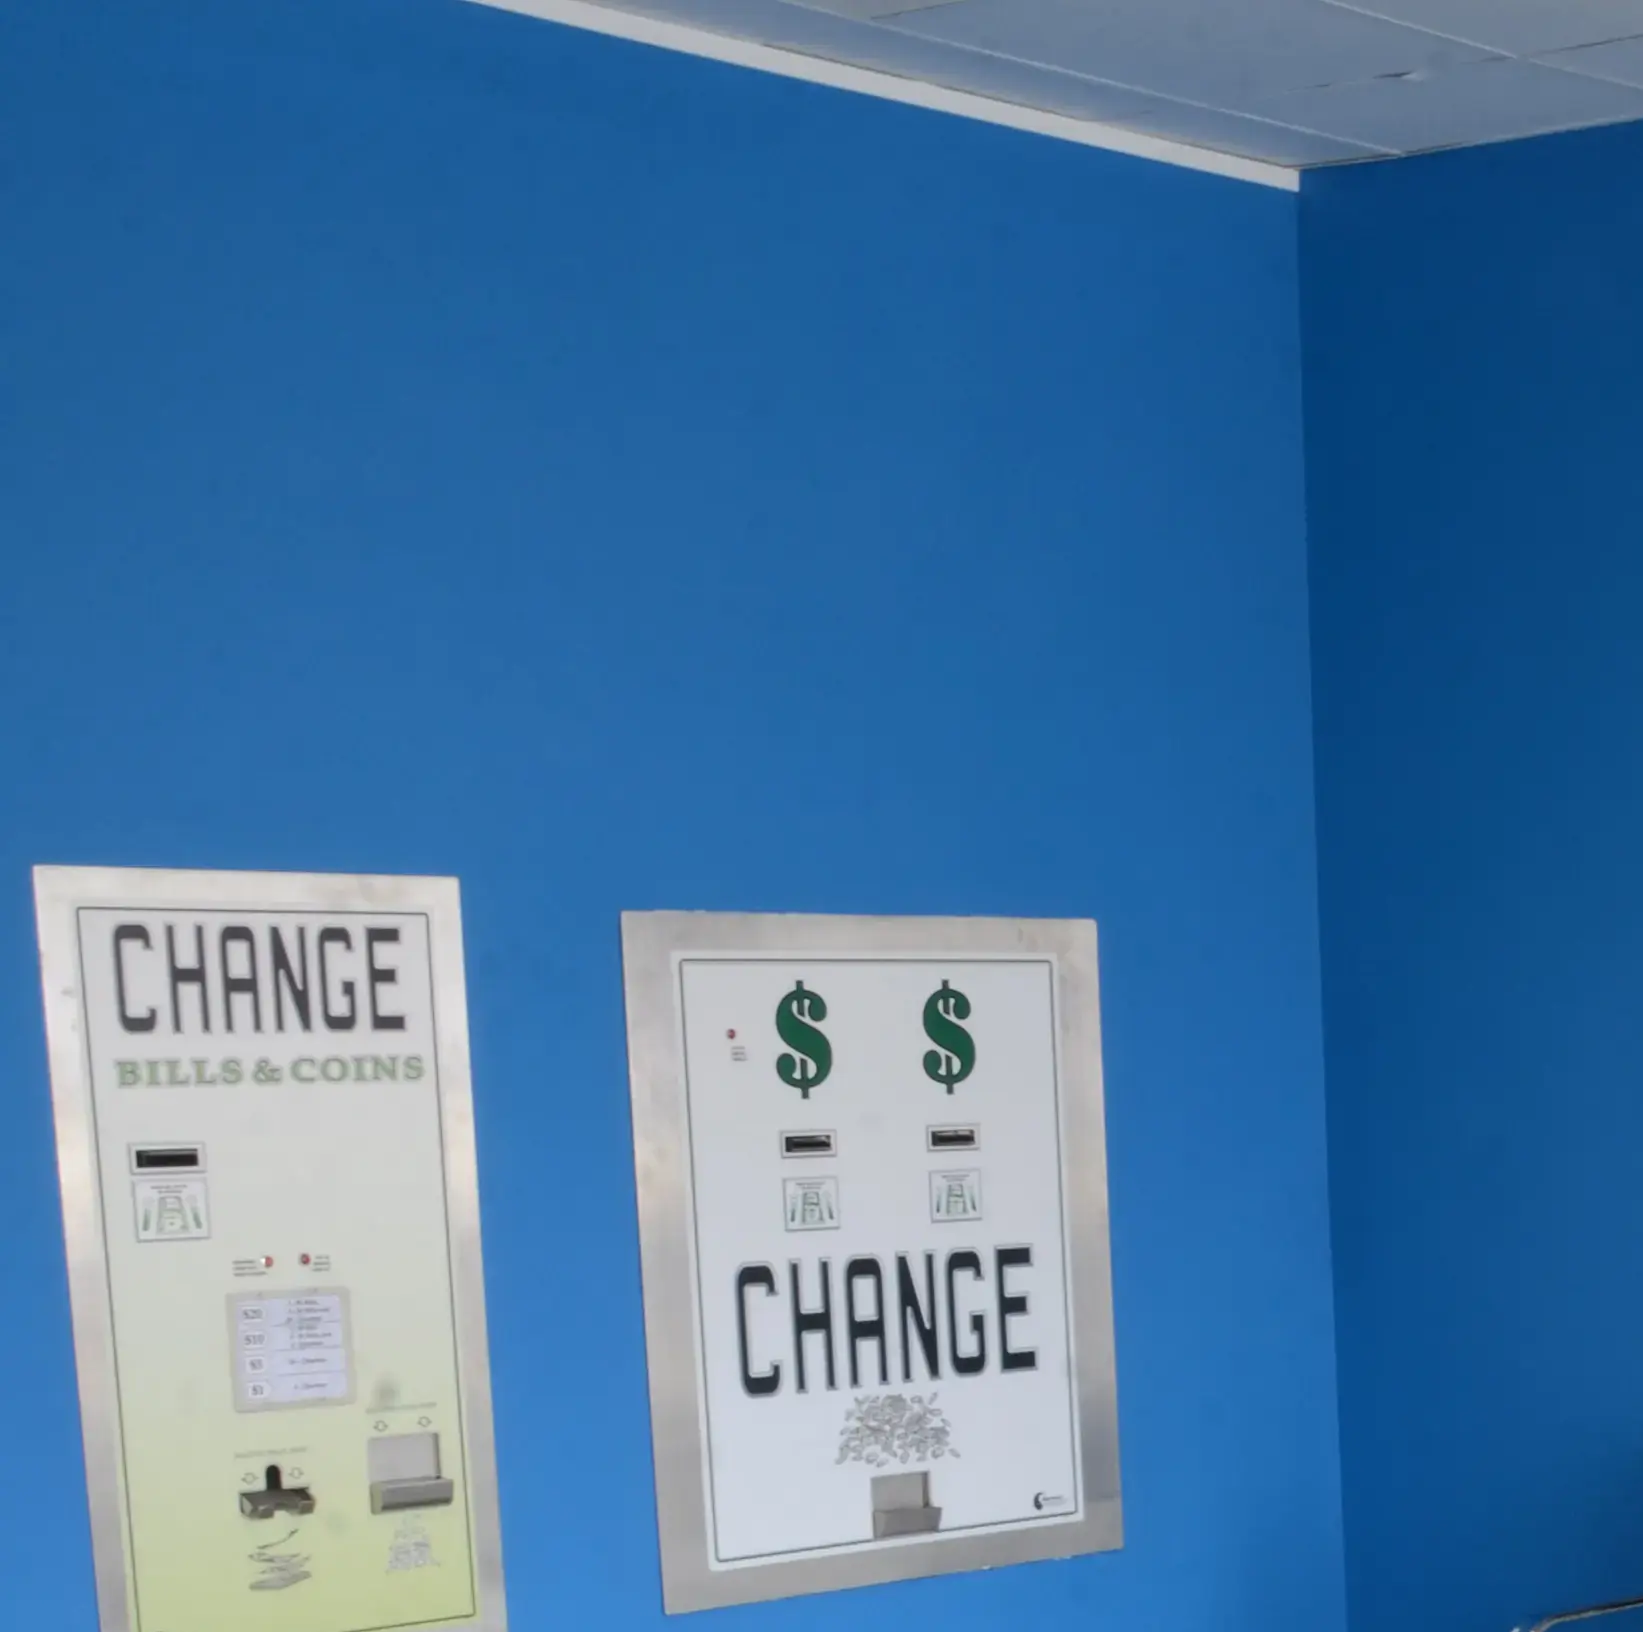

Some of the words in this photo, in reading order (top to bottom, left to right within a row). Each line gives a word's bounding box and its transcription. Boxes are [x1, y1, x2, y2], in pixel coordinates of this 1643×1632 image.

[112, 923, 406, 1034] CHANGE
[114, 1057, 245, 1088] BILLS
[250, 1057, 284, 1085] &
[290, 1055, 426, 1084] COINS
[734, 1244, 1040, 1399] CHANGE
